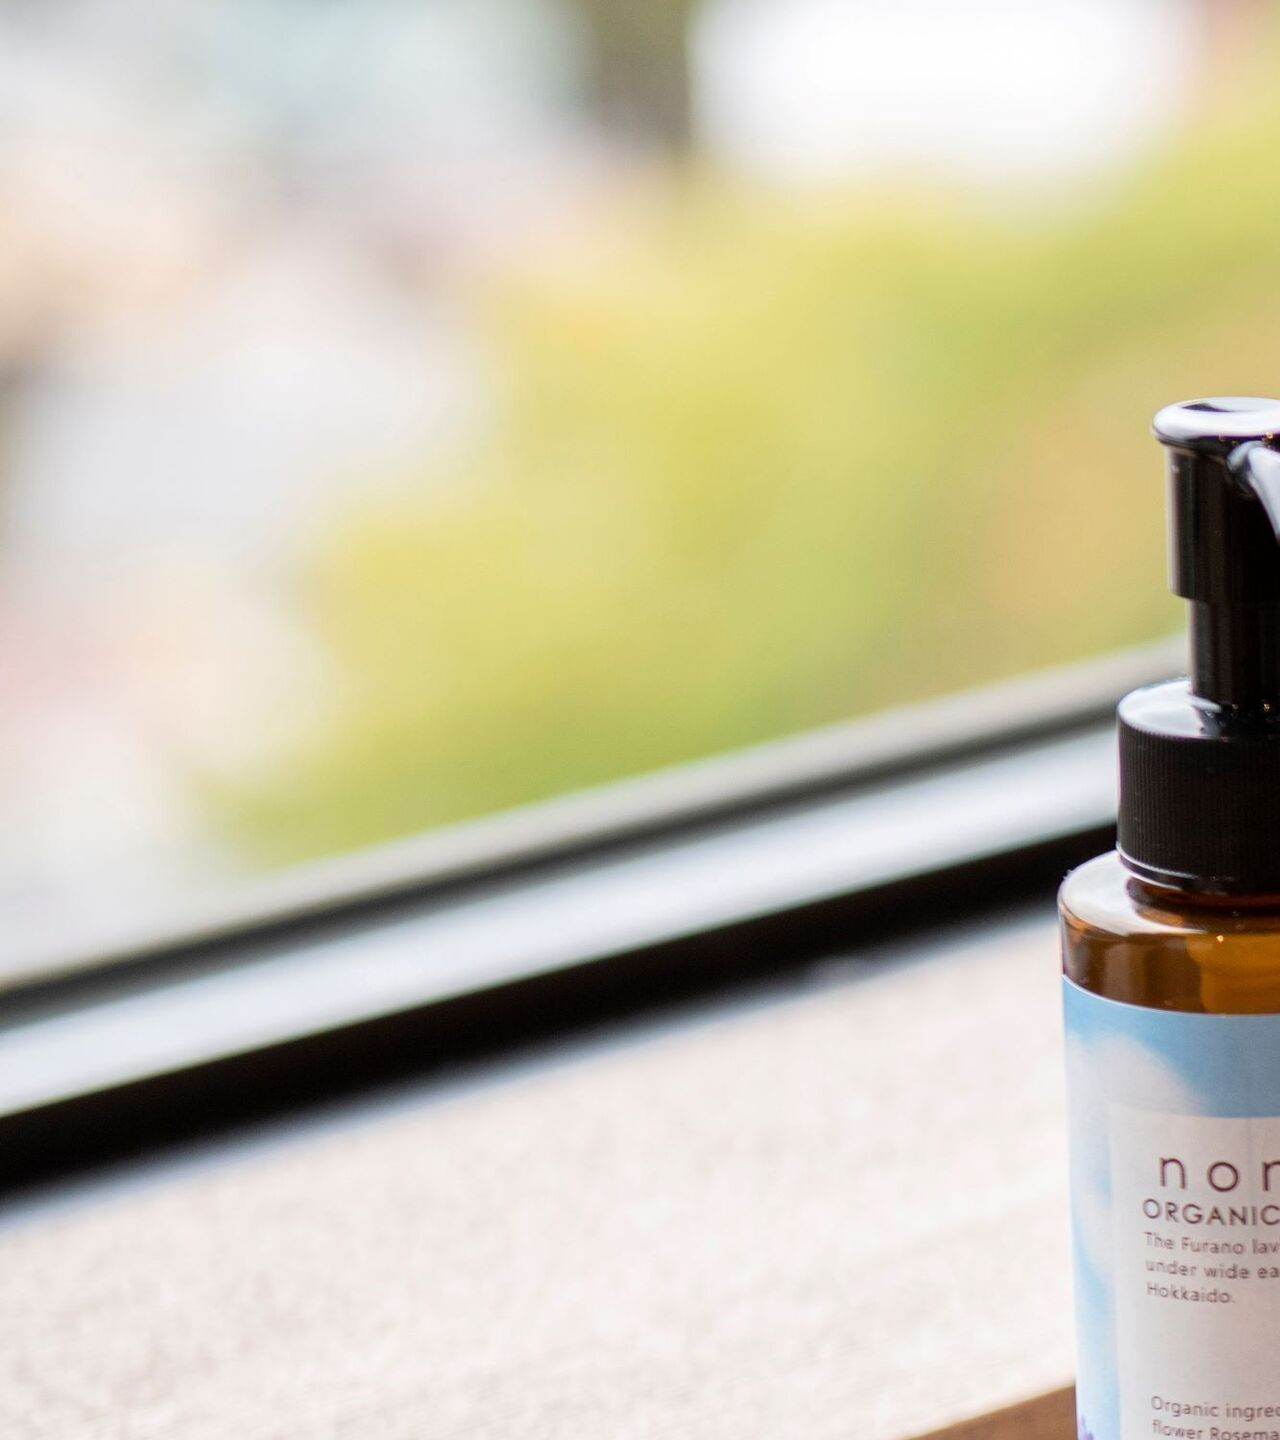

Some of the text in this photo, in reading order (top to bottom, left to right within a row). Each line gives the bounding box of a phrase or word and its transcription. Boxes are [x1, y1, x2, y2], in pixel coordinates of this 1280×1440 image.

[1144, 1231, 1175, 1251] The
[1181, 1237, 1245, 1256] Furano
[1145, 1259, 1196, 1278] under
[1203, 1261, 1250, 1281] wide
[1146, 1283, 1236, 1304] Hokkaido.
[1151, 1395, 1220, 1418] Organic
[1151, 1419, 1202, 1440] flower
